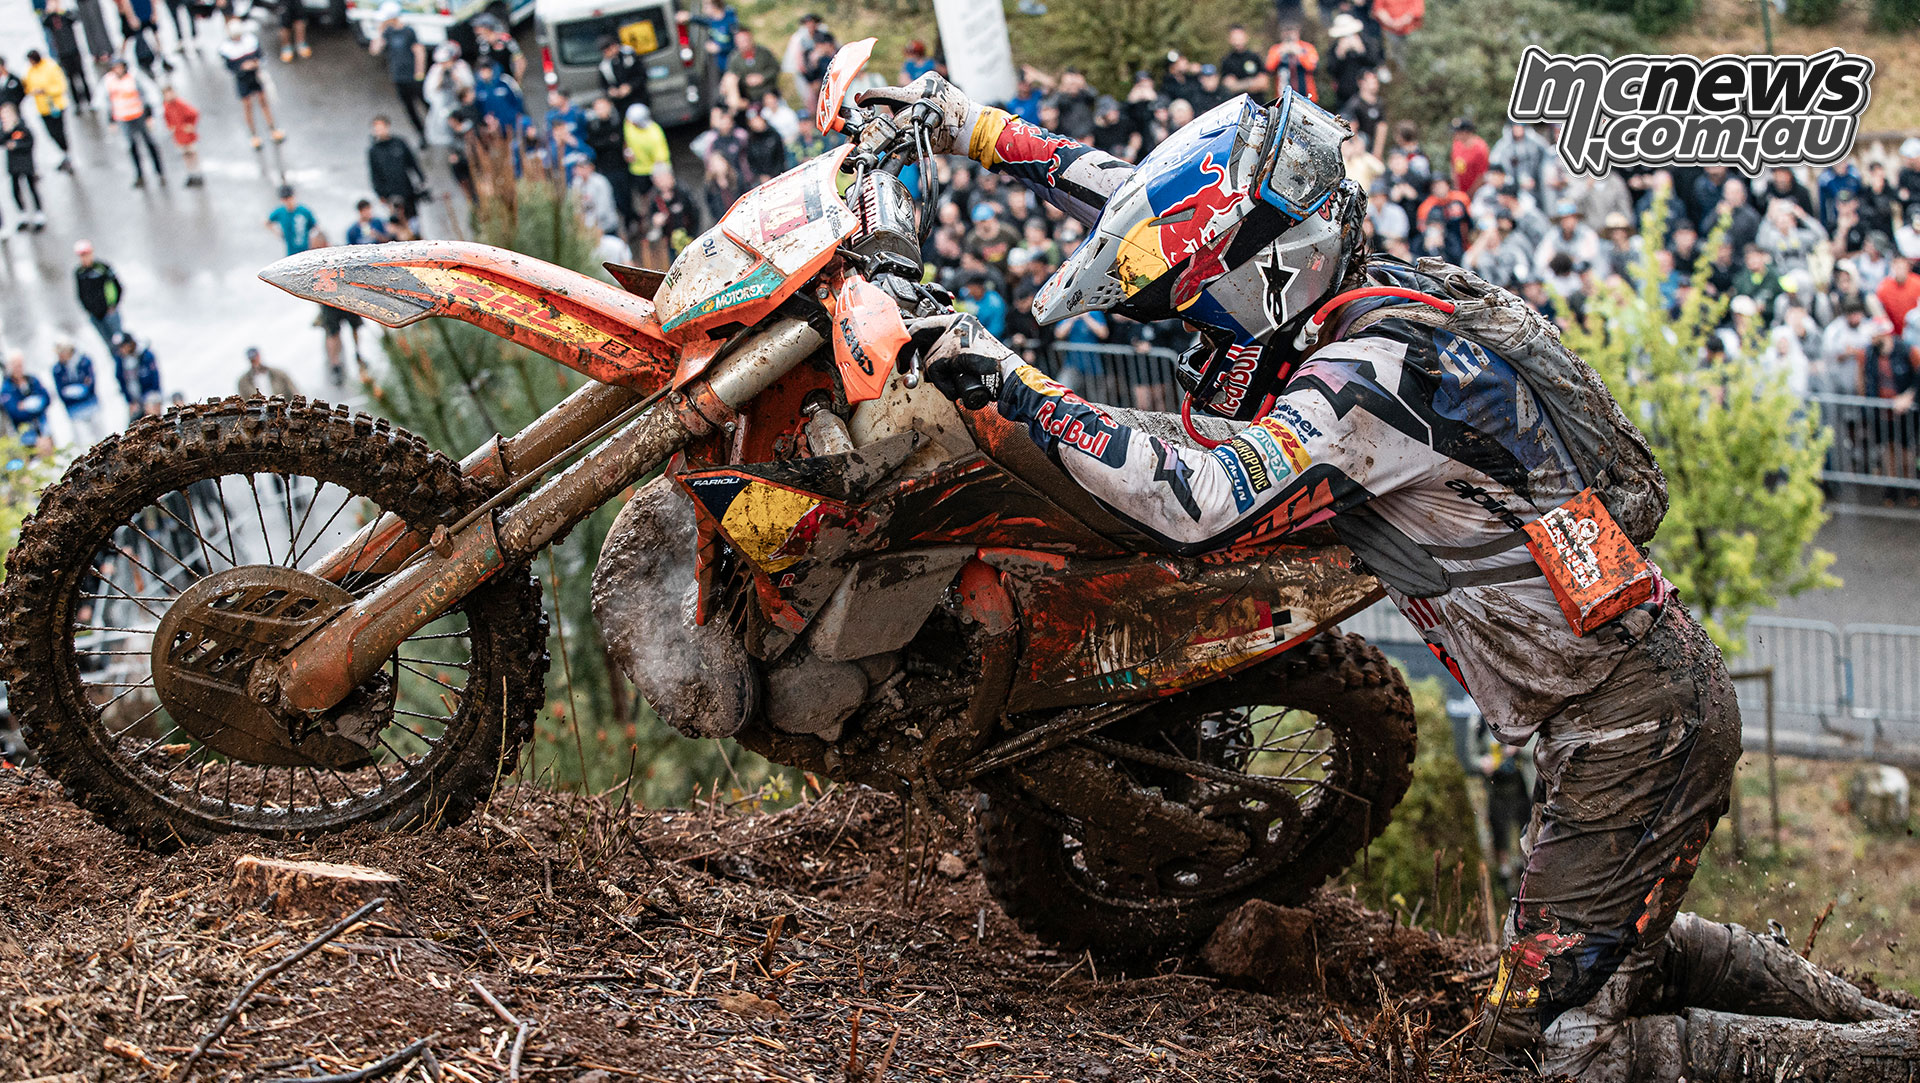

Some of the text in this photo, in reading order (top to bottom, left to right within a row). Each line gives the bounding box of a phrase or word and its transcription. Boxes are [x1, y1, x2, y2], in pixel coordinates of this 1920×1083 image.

[714, 284, 766, 309] MOTOREX
[1062, 419, 1113, 459] Bull
[693, 478, 740, 487] FARIOLI
